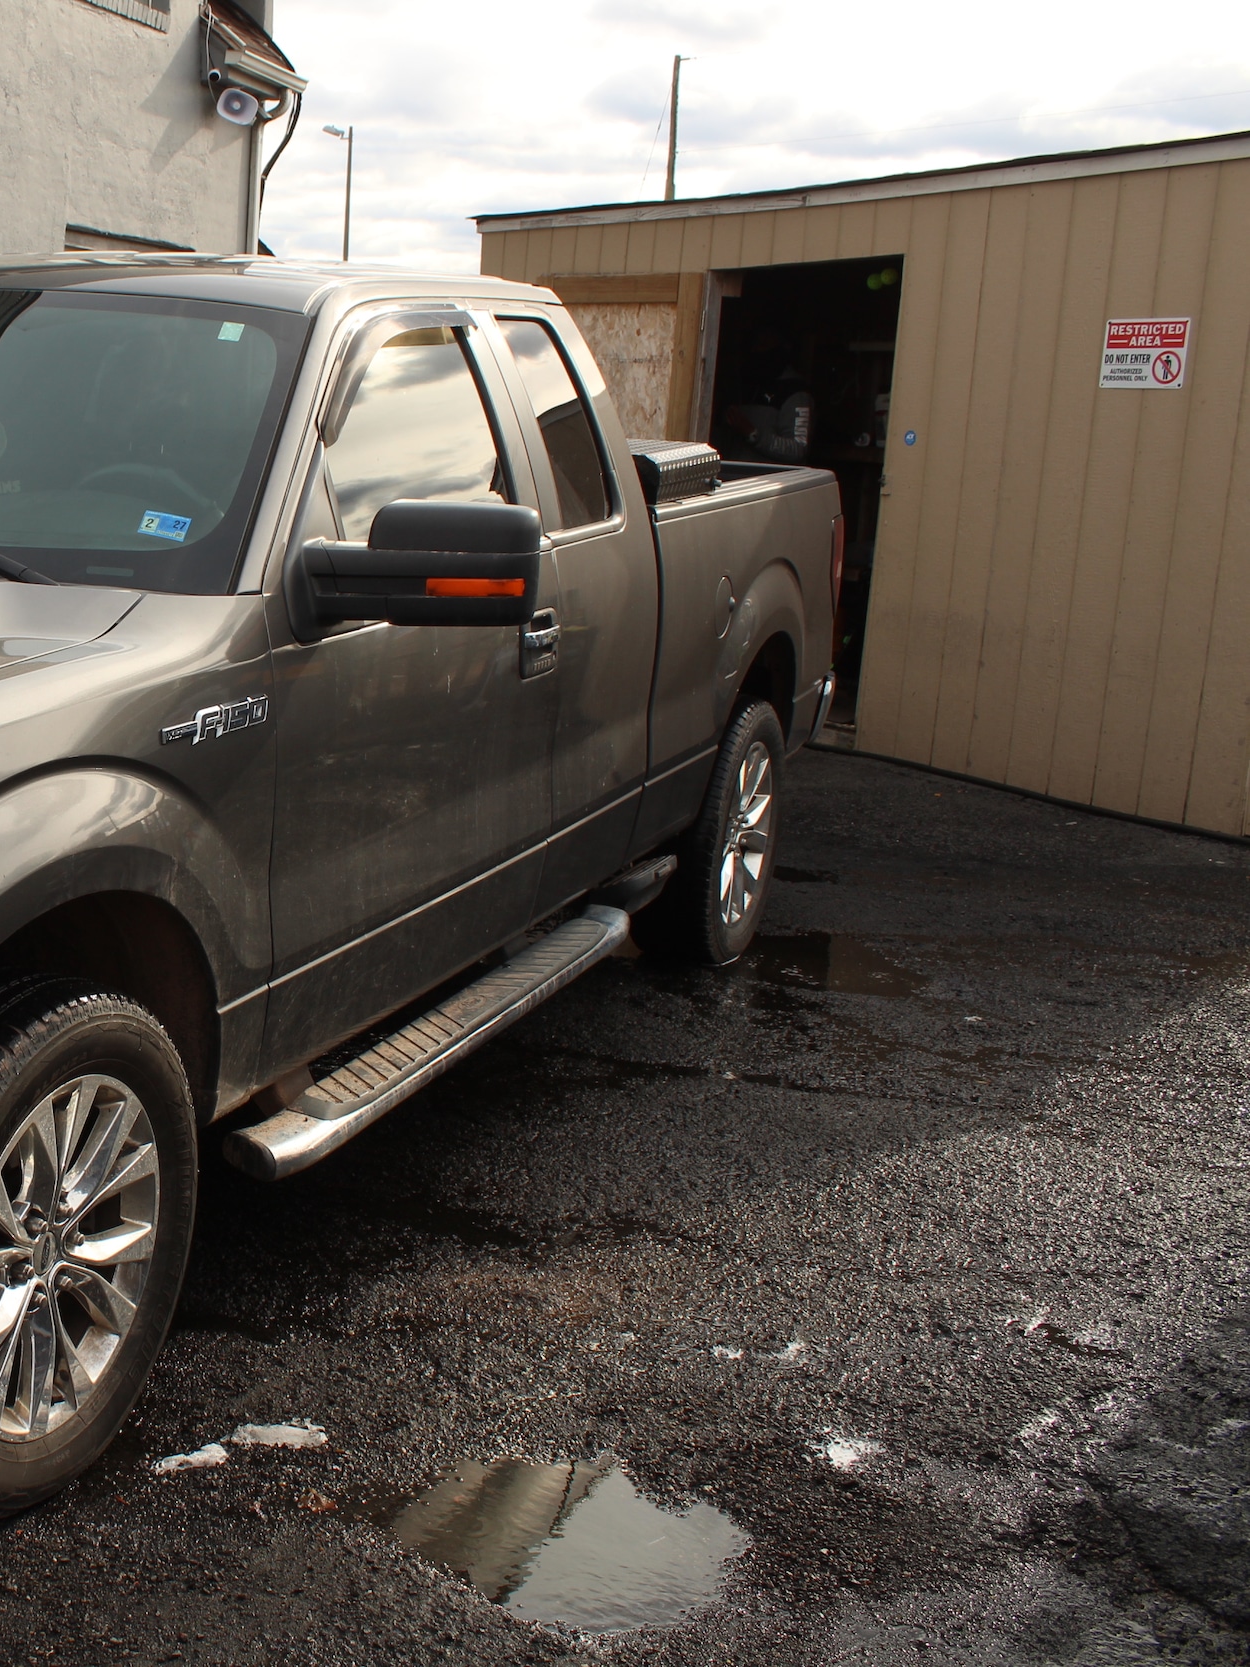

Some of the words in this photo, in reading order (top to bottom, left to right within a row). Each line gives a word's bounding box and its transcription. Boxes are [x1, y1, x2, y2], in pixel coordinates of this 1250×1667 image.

[1110, 324, 1185, 335] RESTRICTED
[1129, 336, 1162, 346] AREA
[1104, 354, 1114, 364] DO
[1116, 354, 1128, 364] NOT
[1130, 353, 1151, 364] ENTER
[145, 518, 154, 529] 2
[173, 520, 187, 530] 27
